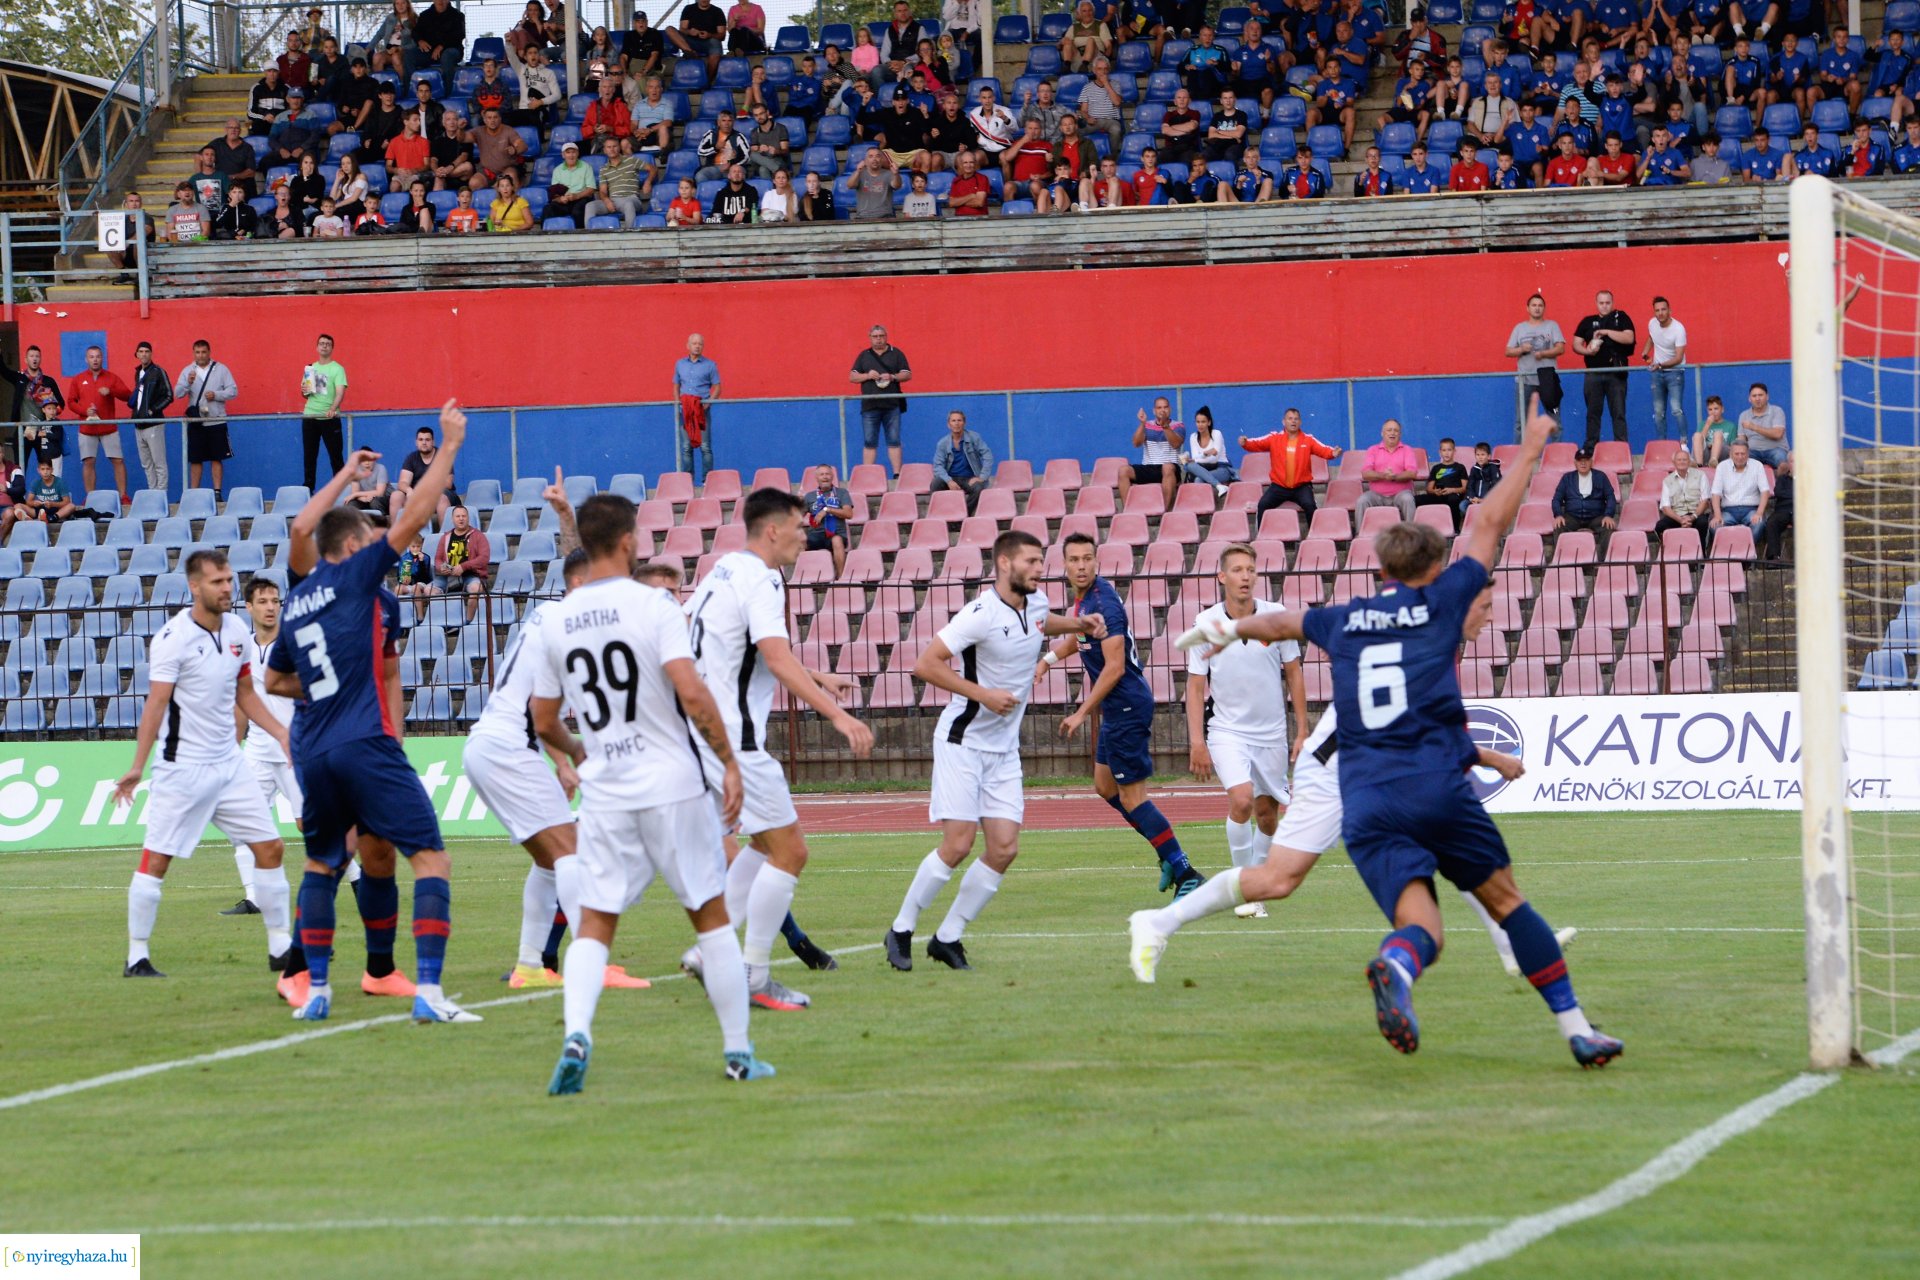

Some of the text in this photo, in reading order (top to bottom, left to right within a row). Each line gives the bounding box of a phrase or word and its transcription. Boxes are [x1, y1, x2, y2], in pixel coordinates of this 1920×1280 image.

[176, 214, 196, 222] MIAMI
[105, 228, 119, 247] C
[565, 608, 621, 634] BARTHA
[294, 622, 340, 702] 3
[566, 640, 639, 732] 39
[1357, 642, 1409, 730] 6
[604, 734, 645, 761] PMFC
[1533, 777, 1646, 802] MÉRNÖKI
[1651, 775, 1803, 800] SZOLGÁLTA
